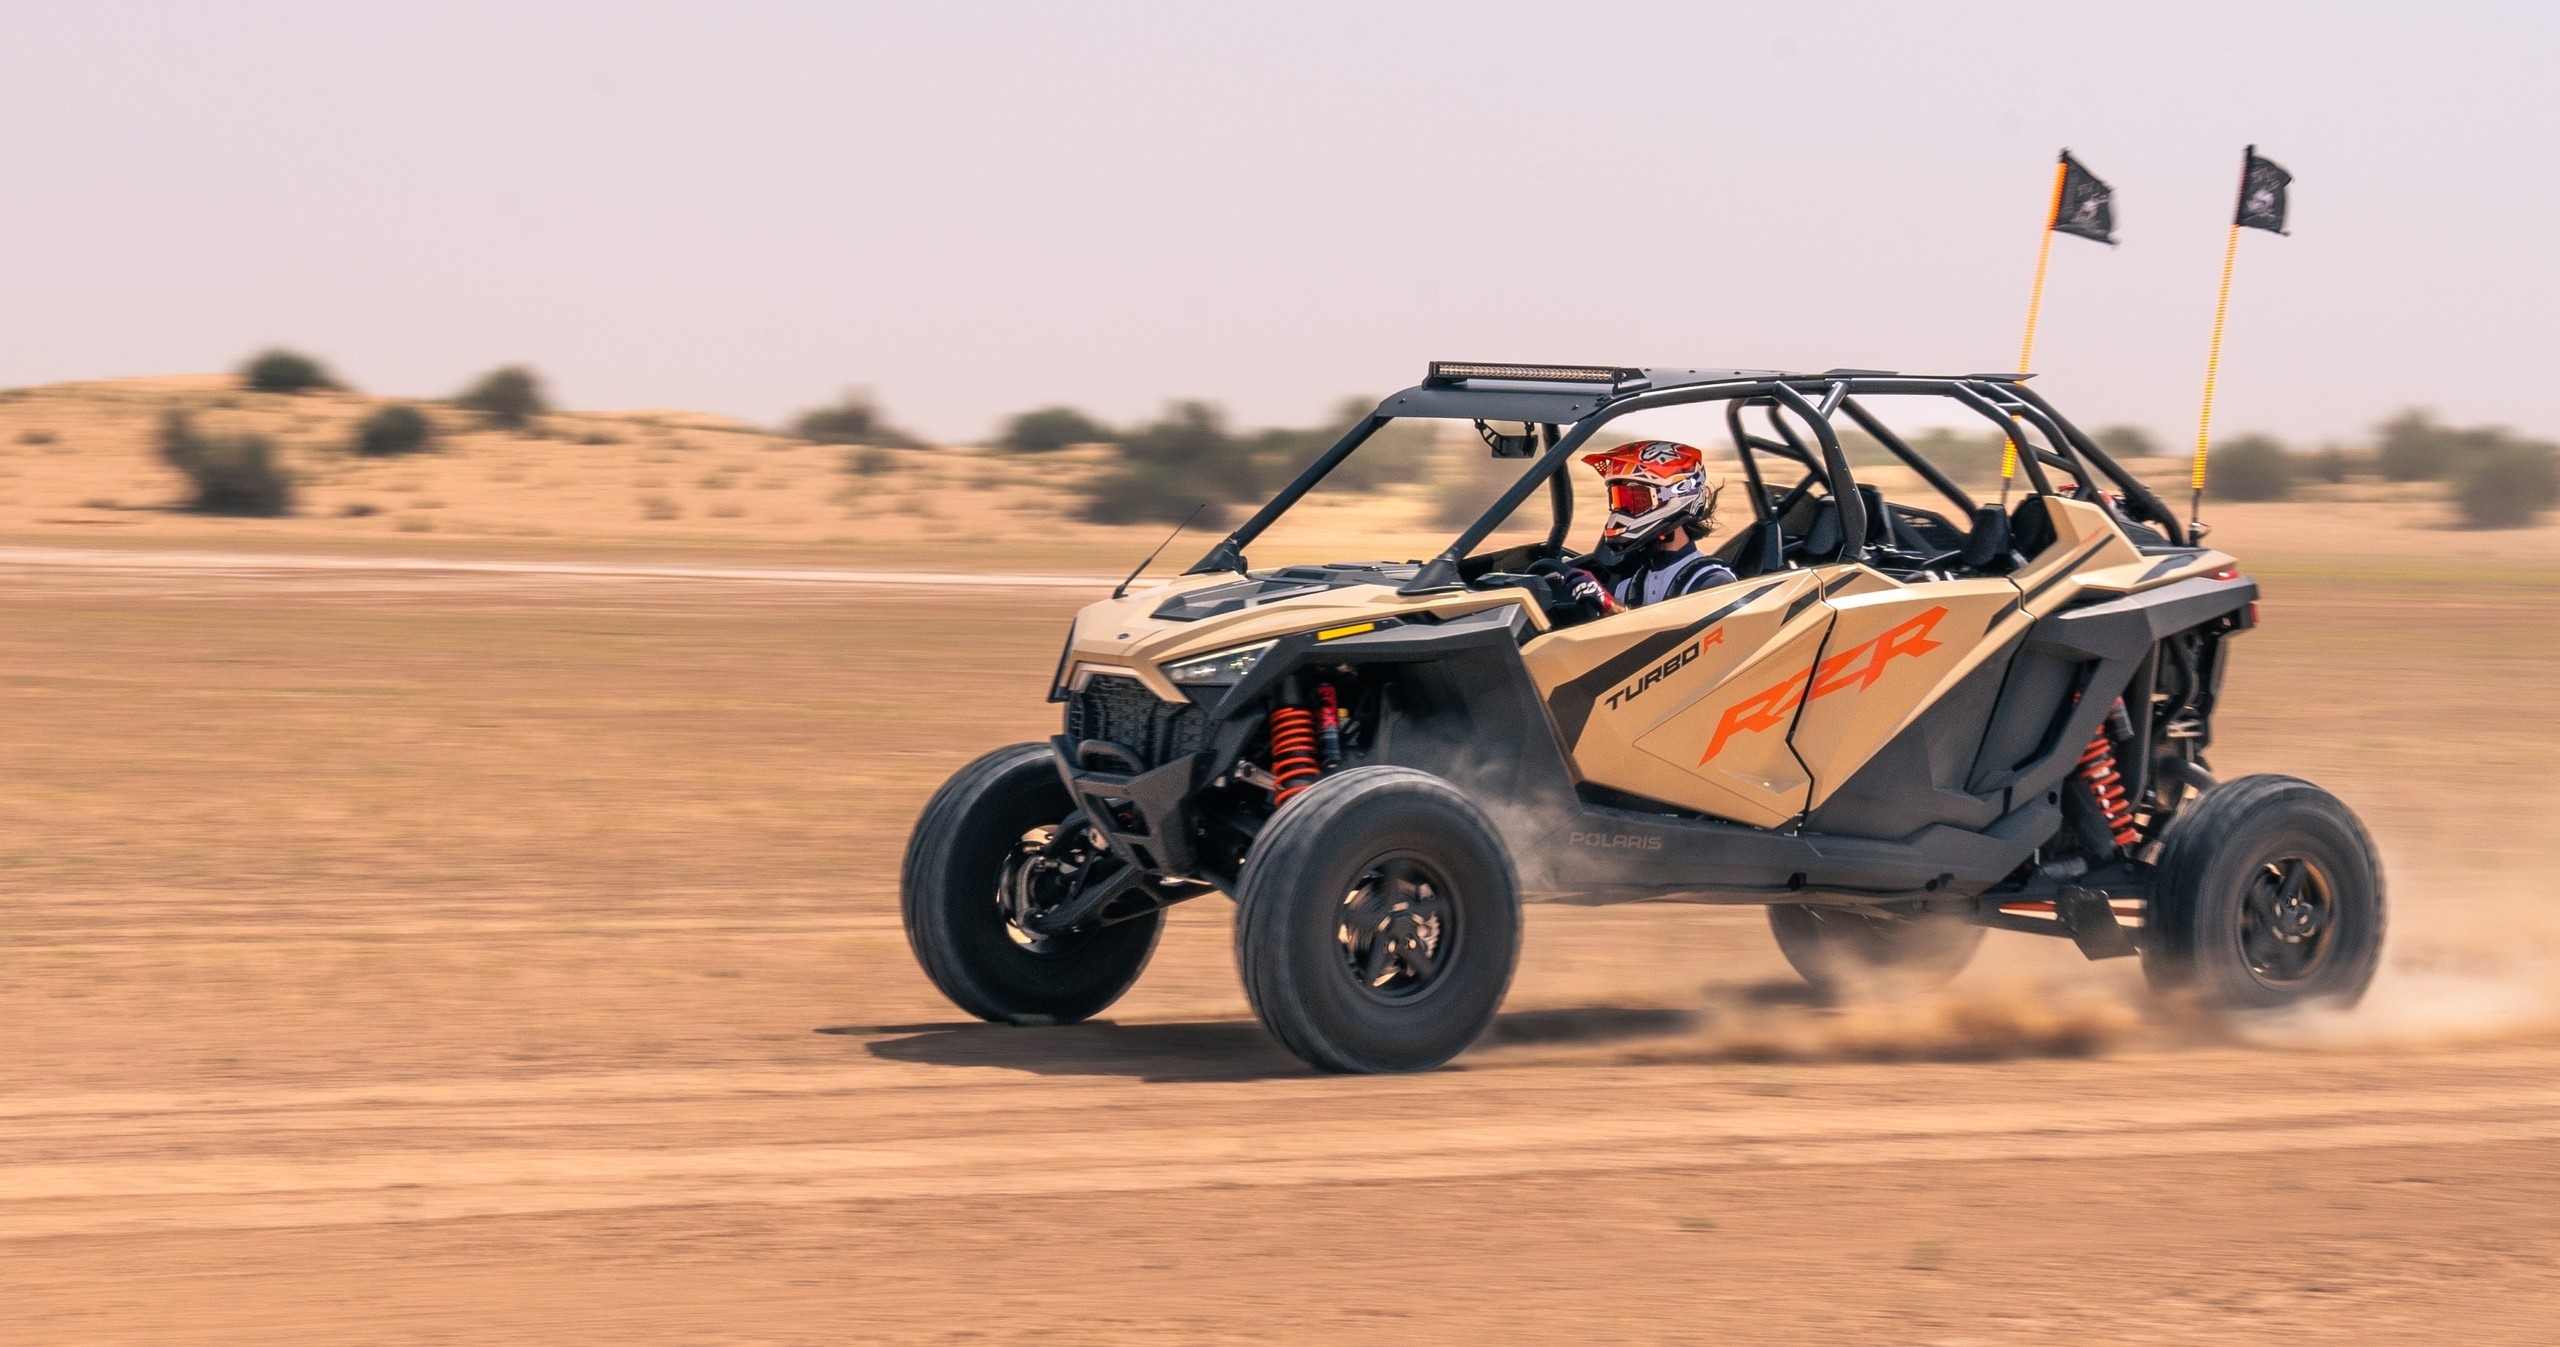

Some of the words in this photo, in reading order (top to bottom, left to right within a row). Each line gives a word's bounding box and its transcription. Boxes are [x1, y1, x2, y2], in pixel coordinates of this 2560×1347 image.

[1604, 641, 1699, 711] TURBO
[1702, 626, 1724, 655] R
[1697, 605, 1949, 769] RZR
[1569, 831, 1664, 850] POLARIS
